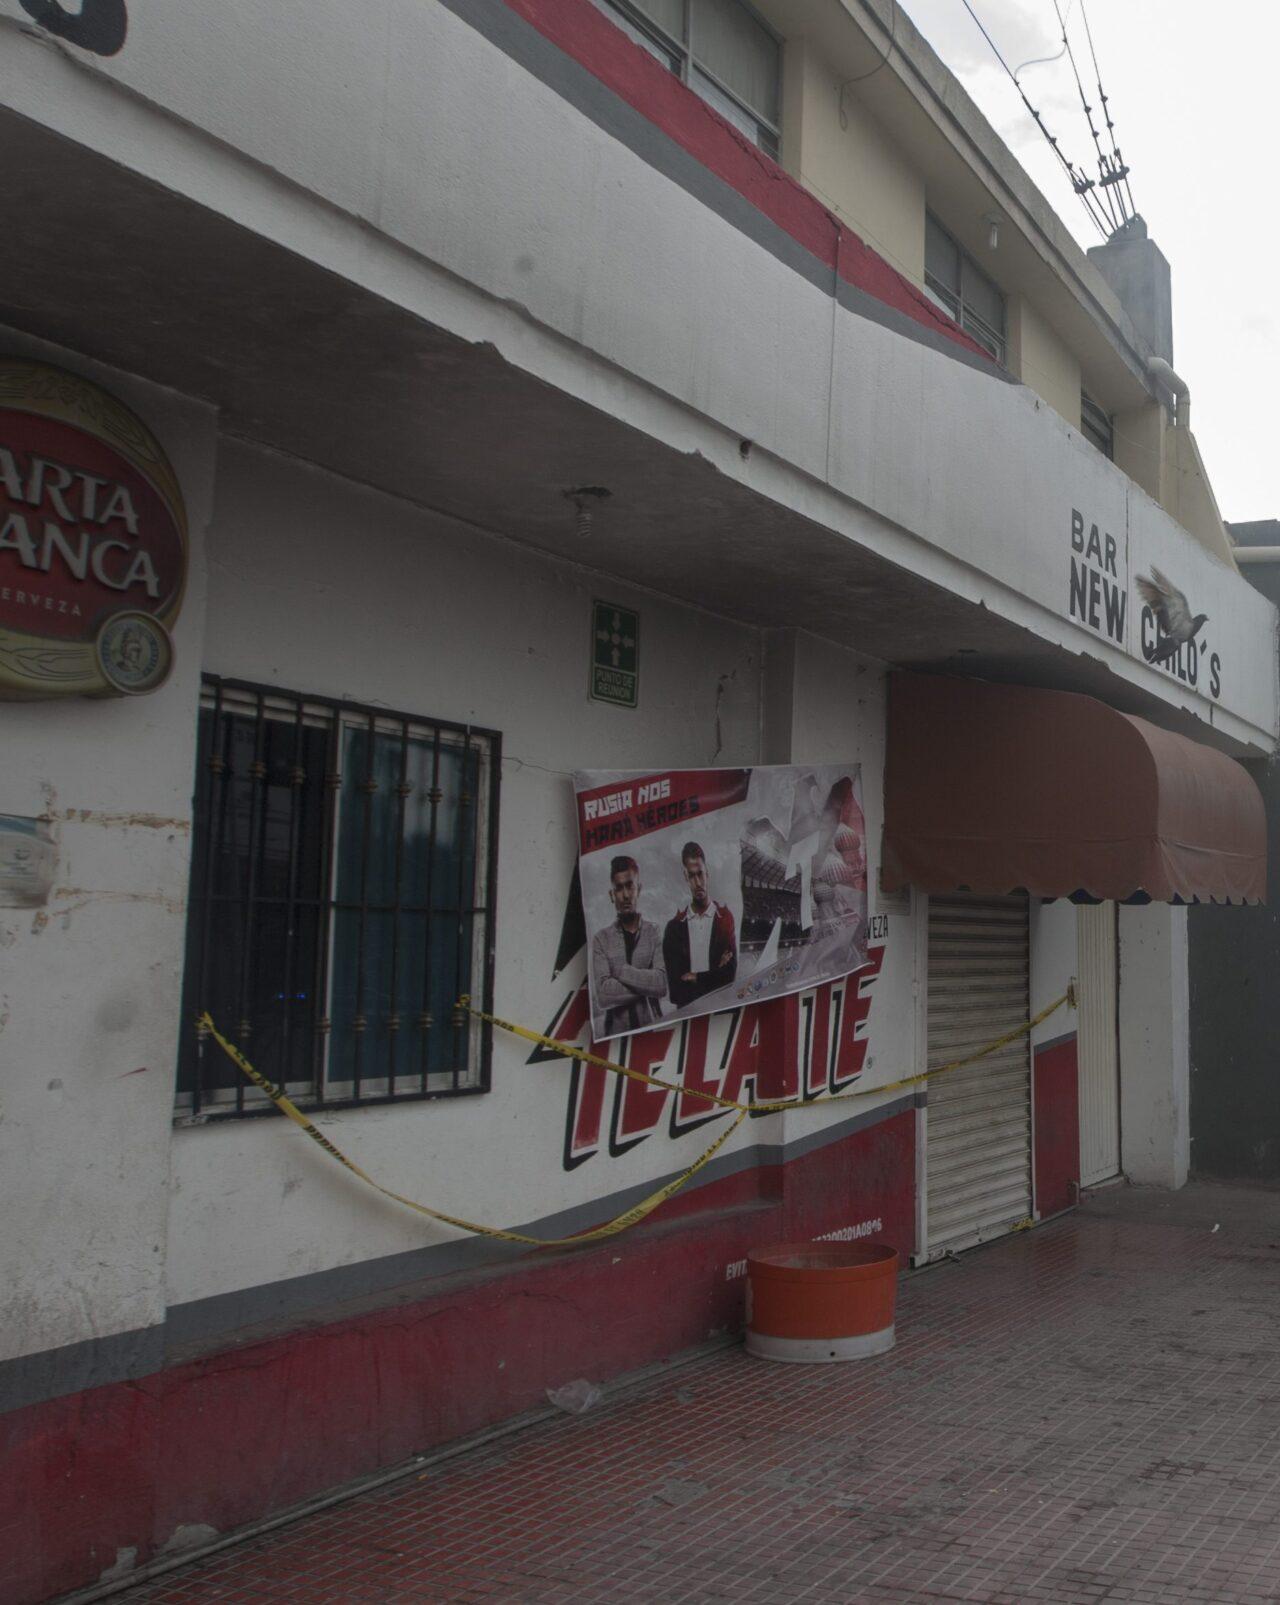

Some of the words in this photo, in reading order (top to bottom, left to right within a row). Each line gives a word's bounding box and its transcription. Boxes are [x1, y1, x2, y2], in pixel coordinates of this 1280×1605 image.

[1071, 507, 1118, 578] BAR
[1069, 555, 1127, 644] NEW
[1141, 604, 1220, 699] CLO'S
[584, 789, 633, 821] RUSIA
[637, 779, 671, 805] NOS
[725, 1258, 749, 1282] EVIT
